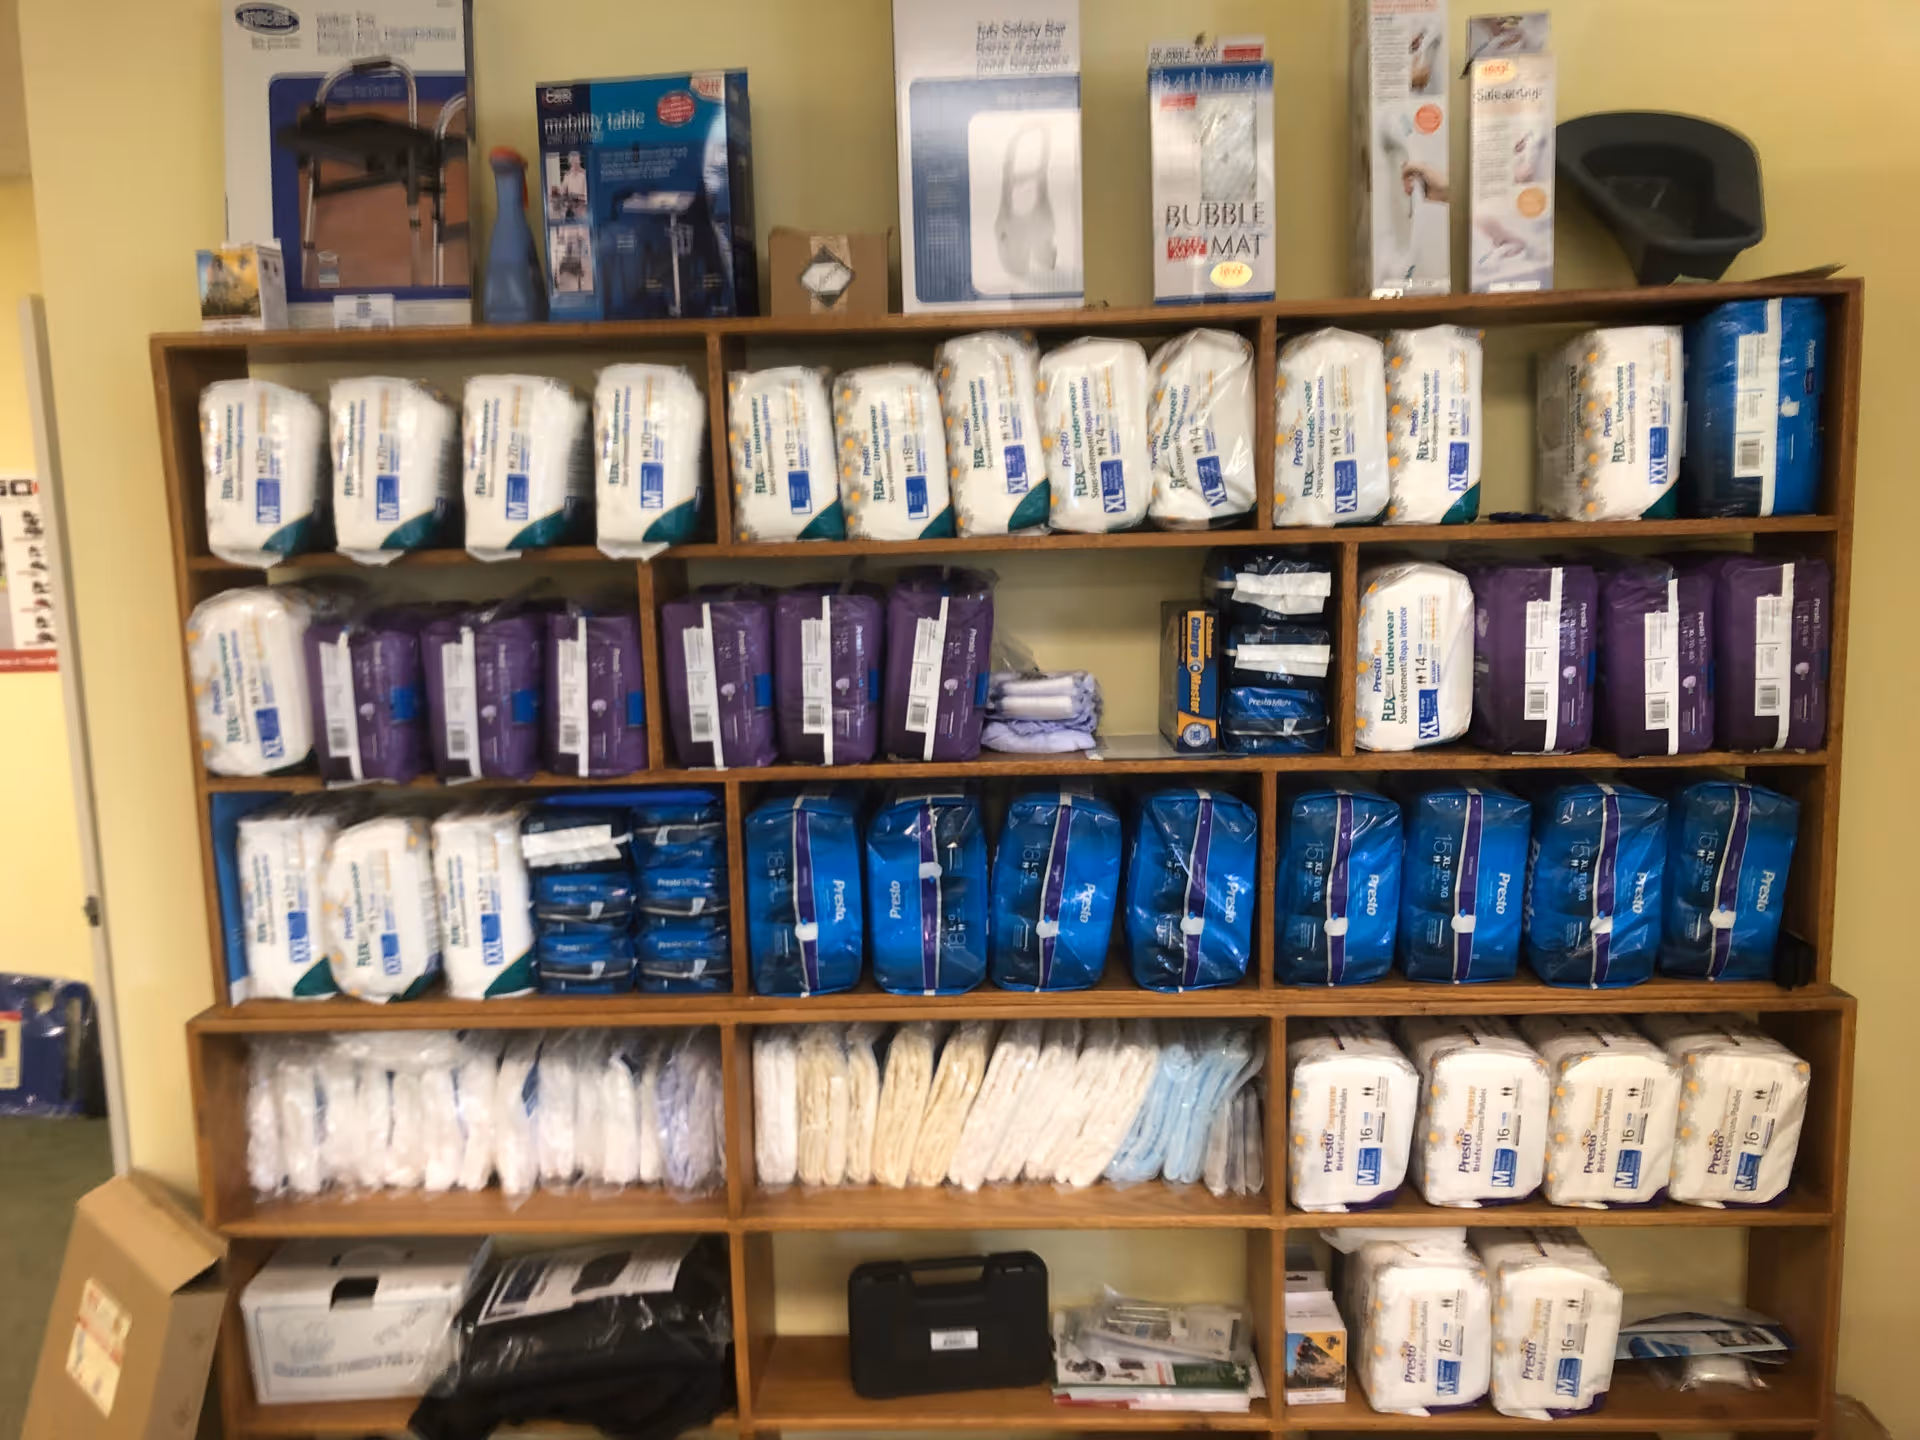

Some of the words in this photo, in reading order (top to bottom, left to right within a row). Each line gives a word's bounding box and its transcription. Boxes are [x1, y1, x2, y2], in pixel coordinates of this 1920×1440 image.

[1166, 201, 1265, 230] BUBBLE
[1210, 233, 1267, 259] MAT
[1330, 428, 1342, 444] 14
[1293, 429, 1304, 466] Presto
[1450, 471, 1468, 490] XL
[1650, 455, 1668, 484] XXL
[1008, 472, 1028, 494] XL
[1205, 482, 1226, 506] XL
[508, 502, 526, 518] M
[642, 490, 662, 508] M
[1104, 490, 1126, 512] XL
[1336, 490, 1357, 512] XL
[379, 502, 397, 519] M
[1400, 606, 1408, 638] interior
[1190, 616, 1202, 658] Charge
[1385, 609, 1394, 675] Underwear
[1372, 658, 1382, 692] Presto
[1416, 657, 1428, 672] 14
[1381, 696, 1396, 722] FLEX
[1420, 716, 1438, 738] XL
[1434, 834, 1452, 854] 15
[1570, 838, 1590, 858] 15
[1699, 829, 1718, 848] 15
[1022, 842, 1040, 861] 18
[1306, 841, 1324, 860] 15
[833, 879, 846, 920] Presto
[889, 880, 902, 919] Presto
[1366, 874, 1380, 916] Presto
[1496, 872, 1511, 914] Presto
[1632, 872, 1646, 914] Presto
[1756, 870, 1776, 912] Presto
[1080, 882, 1096, 923] Presto
[1225, 882, 1240, 923] Presto
[1360, 1128, 1373, 1142] 16
[1497, 1128, 1510, 1142] 16
[1621, 1129, 1634, 1144] 16
[1743, 1132, 1759, 1146] 16
[1324, 1134, 1334, 1172] Presto
[1458, 1134, 1472, 1173] Presto
[1584, 1134, 1598, 1173] Presto
[1708, 1136, 1724, 1174] Presto
[1358, 1170, 1375, 1184] M
[1492, 1170, 1510, 1186] M
[1614, 1172, 1634, 1188] M
[1734, 1175, 1752, 1191] M
[1438, 1339, 1452, 1352] 16
[1561, 1339, 1575, 1352] 16
[1404, 1345, 1416, 1384] Presto
[1522, 1342, 1536, 1380] Presto
[1437, 1380, 1456, 1396] M
[1556, 1379, 1574, 1395] M
